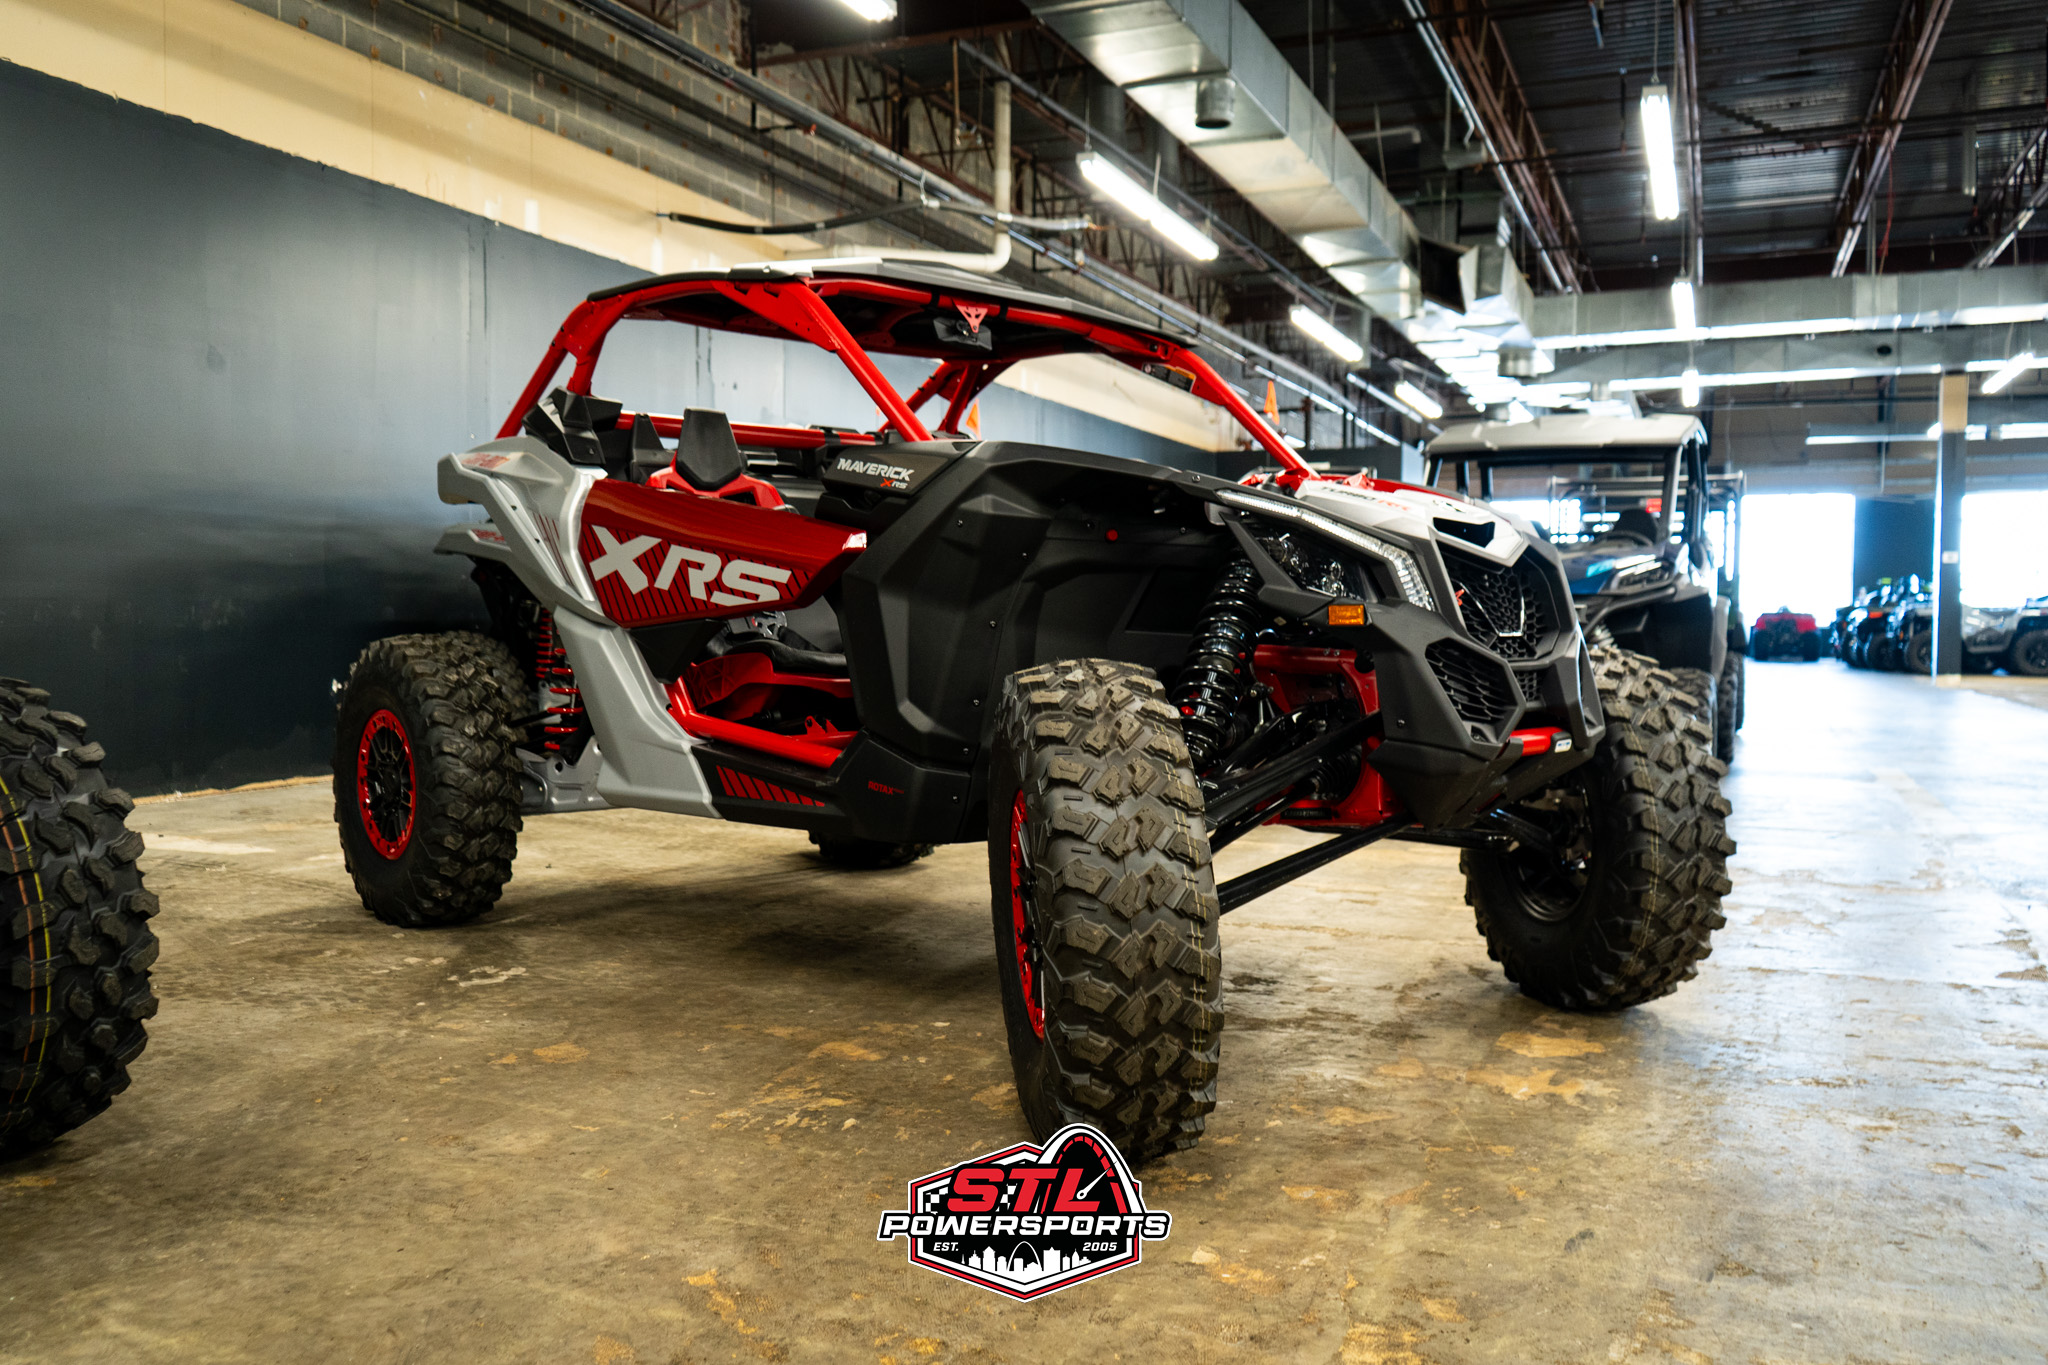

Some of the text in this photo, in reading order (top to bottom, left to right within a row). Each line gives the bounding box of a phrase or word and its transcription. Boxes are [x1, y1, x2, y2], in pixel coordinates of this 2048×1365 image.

[837, 458, 915, 481] MAVERICK
[880, 478, 908, 489] XRS
[589, 524, 792, 607] XRS
[868, 780, 893, 795] ROTAX
